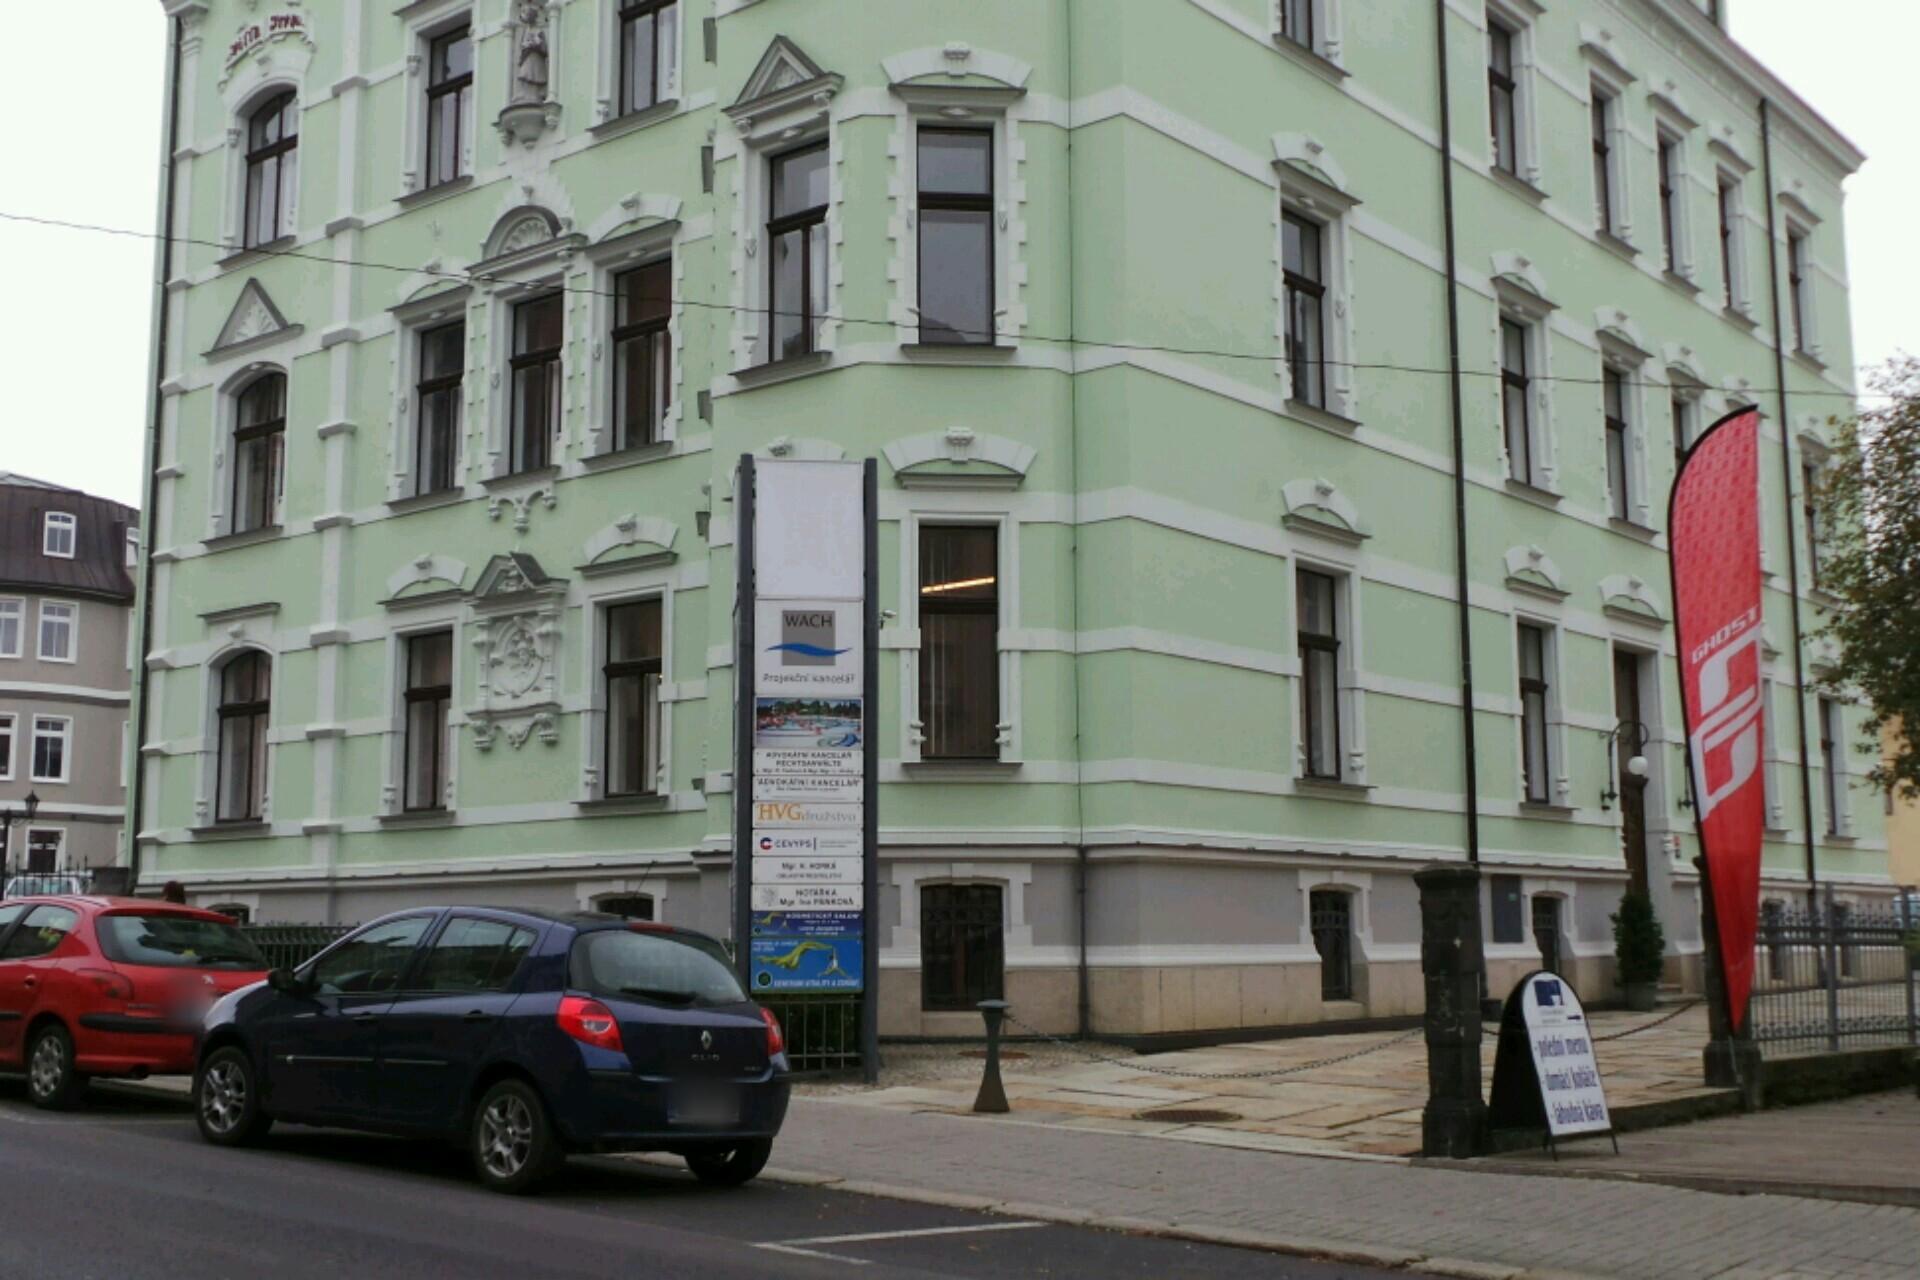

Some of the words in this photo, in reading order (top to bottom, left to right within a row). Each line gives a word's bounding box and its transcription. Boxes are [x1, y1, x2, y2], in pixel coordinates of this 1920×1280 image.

[784, 614, 833, 628] WACH
[1691, 604, 1761, 664] GHOST
[763, 672, 809, 684] Projekční
